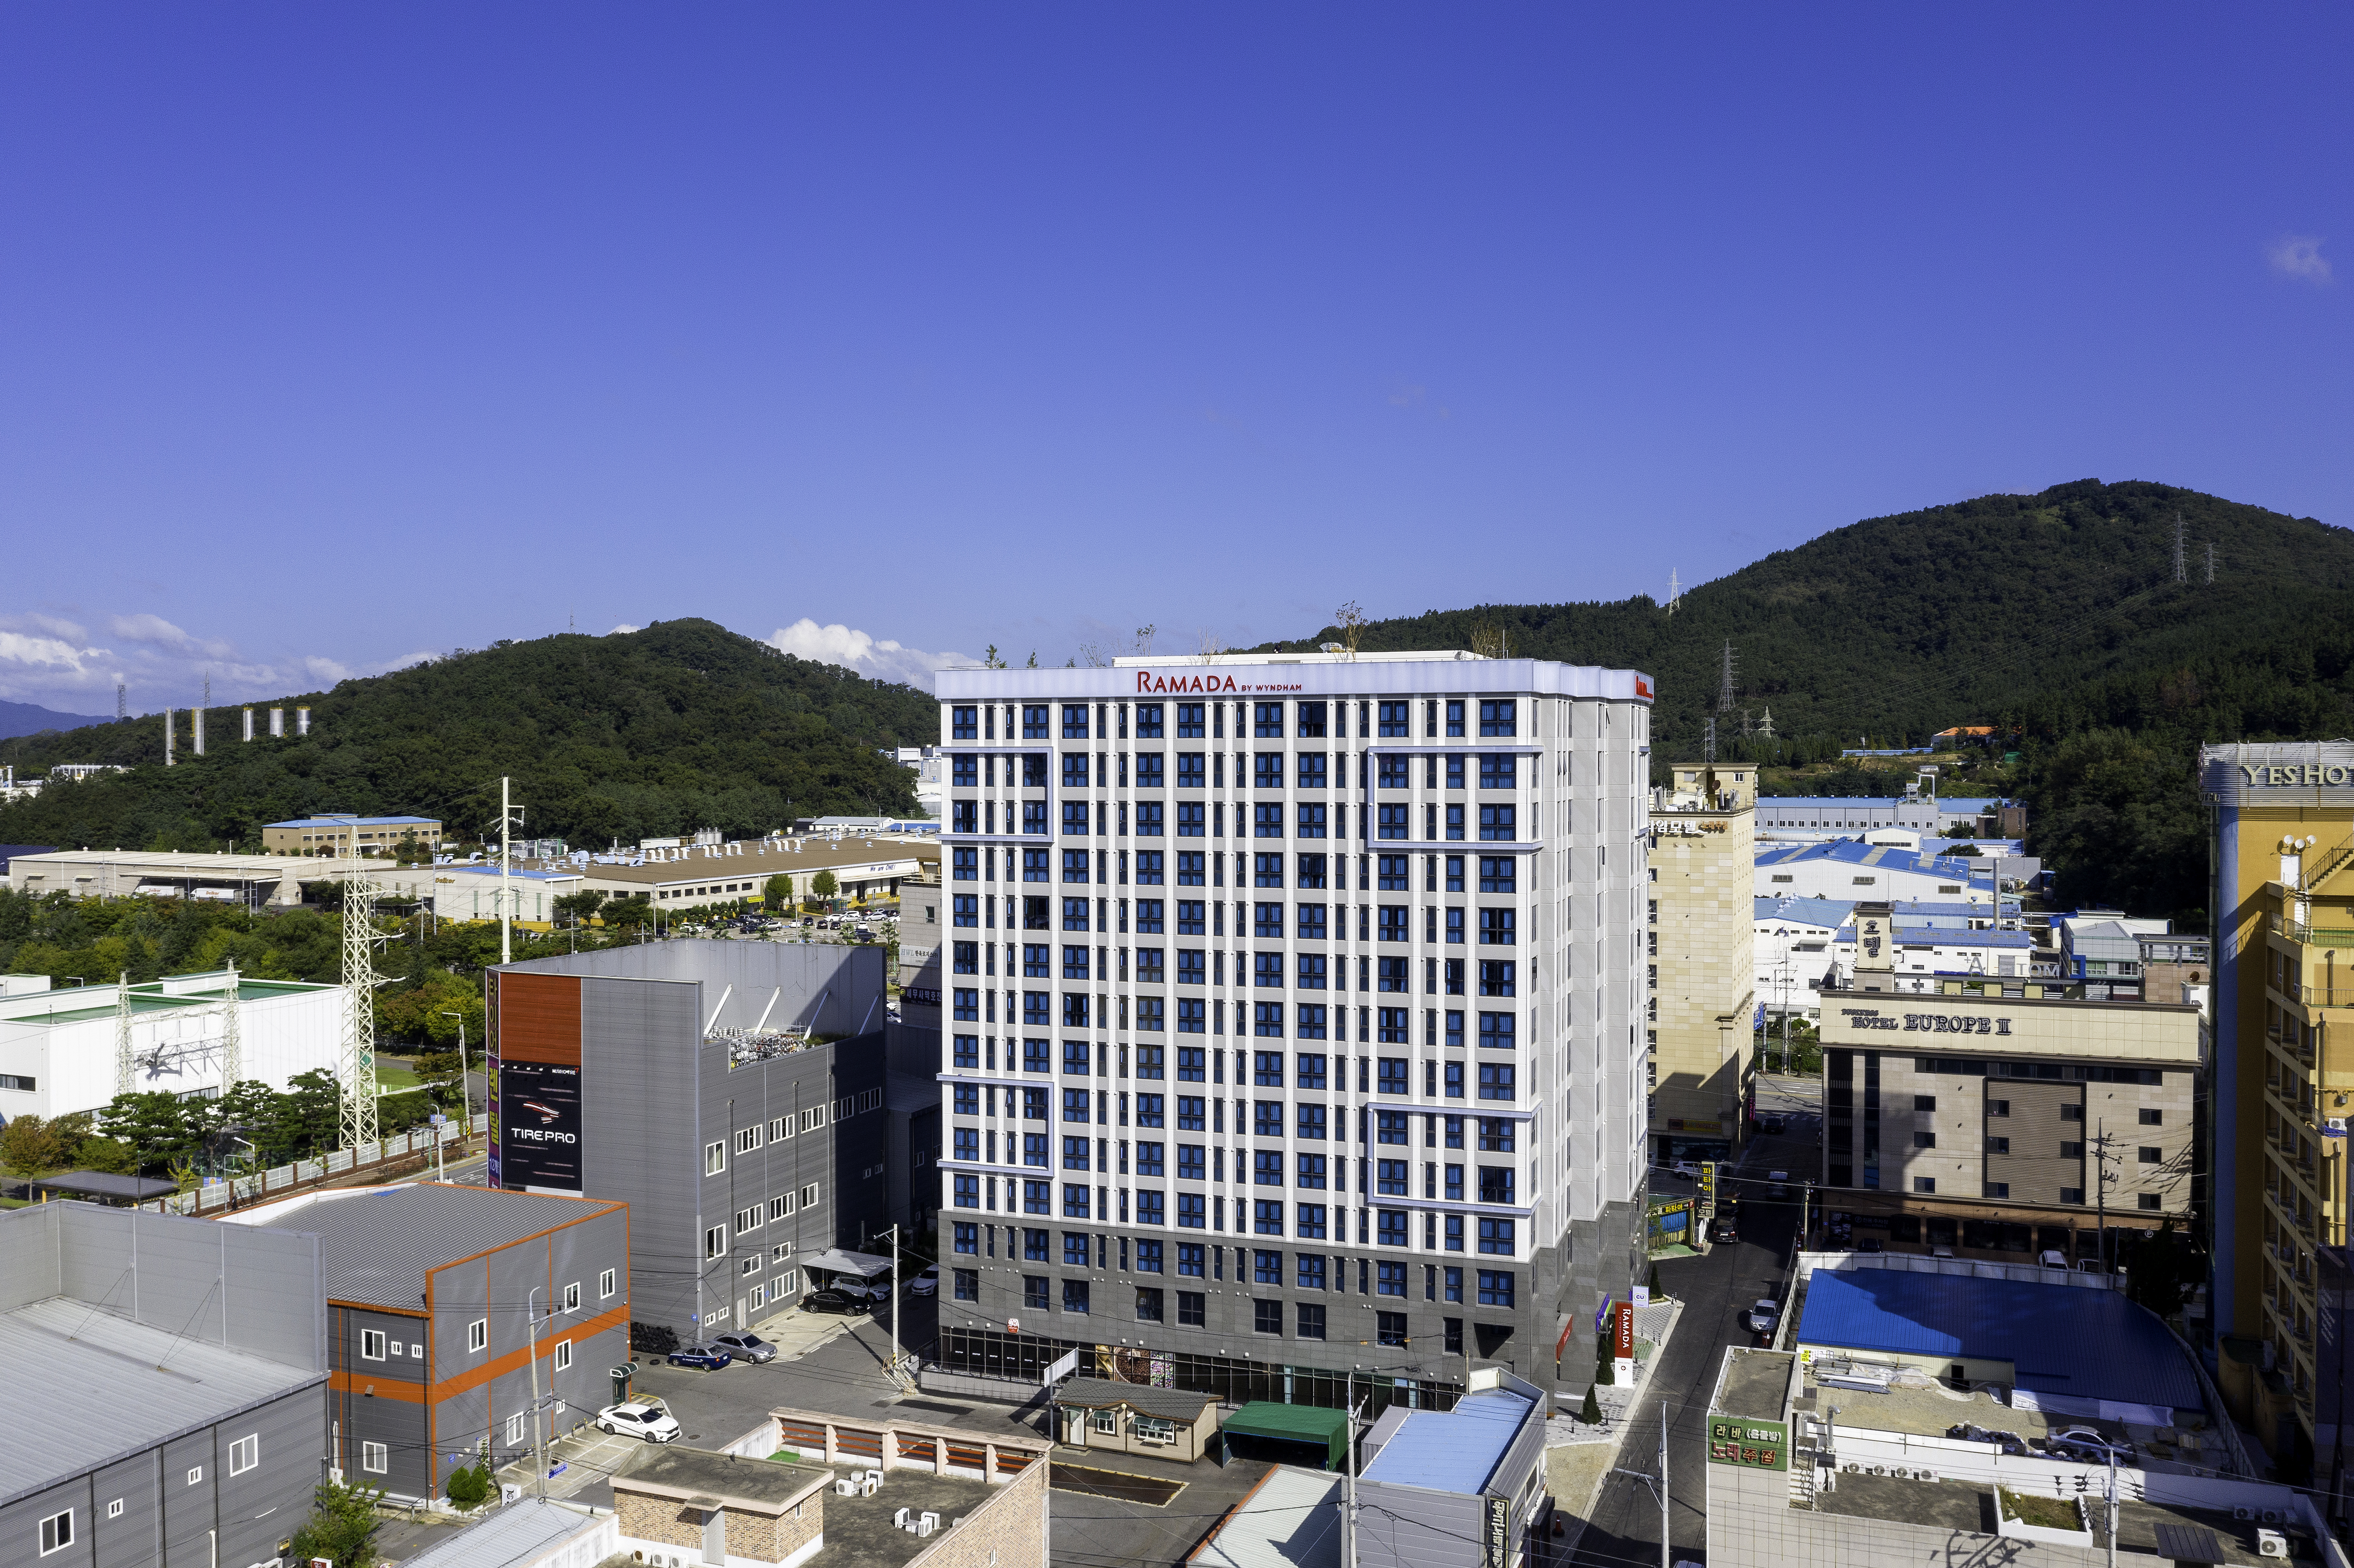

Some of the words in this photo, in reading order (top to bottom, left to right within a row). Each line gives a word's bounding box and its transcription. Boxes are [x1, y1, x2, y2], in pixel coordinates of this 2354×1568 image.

[1137, 671, 1237, 693] RAMADA
[1864, 920, 1881, 958] 호텔
[1851, 1016, 1899, 1030] HOTEL
[1903, 1014, 1992, 1034] EUROPE
[1703, 1167, 1712, 1192] 파타야
[1665, 1203, 1683, 1213] 파타야
[1622, 1309, 1631, 1348] RAMADA
